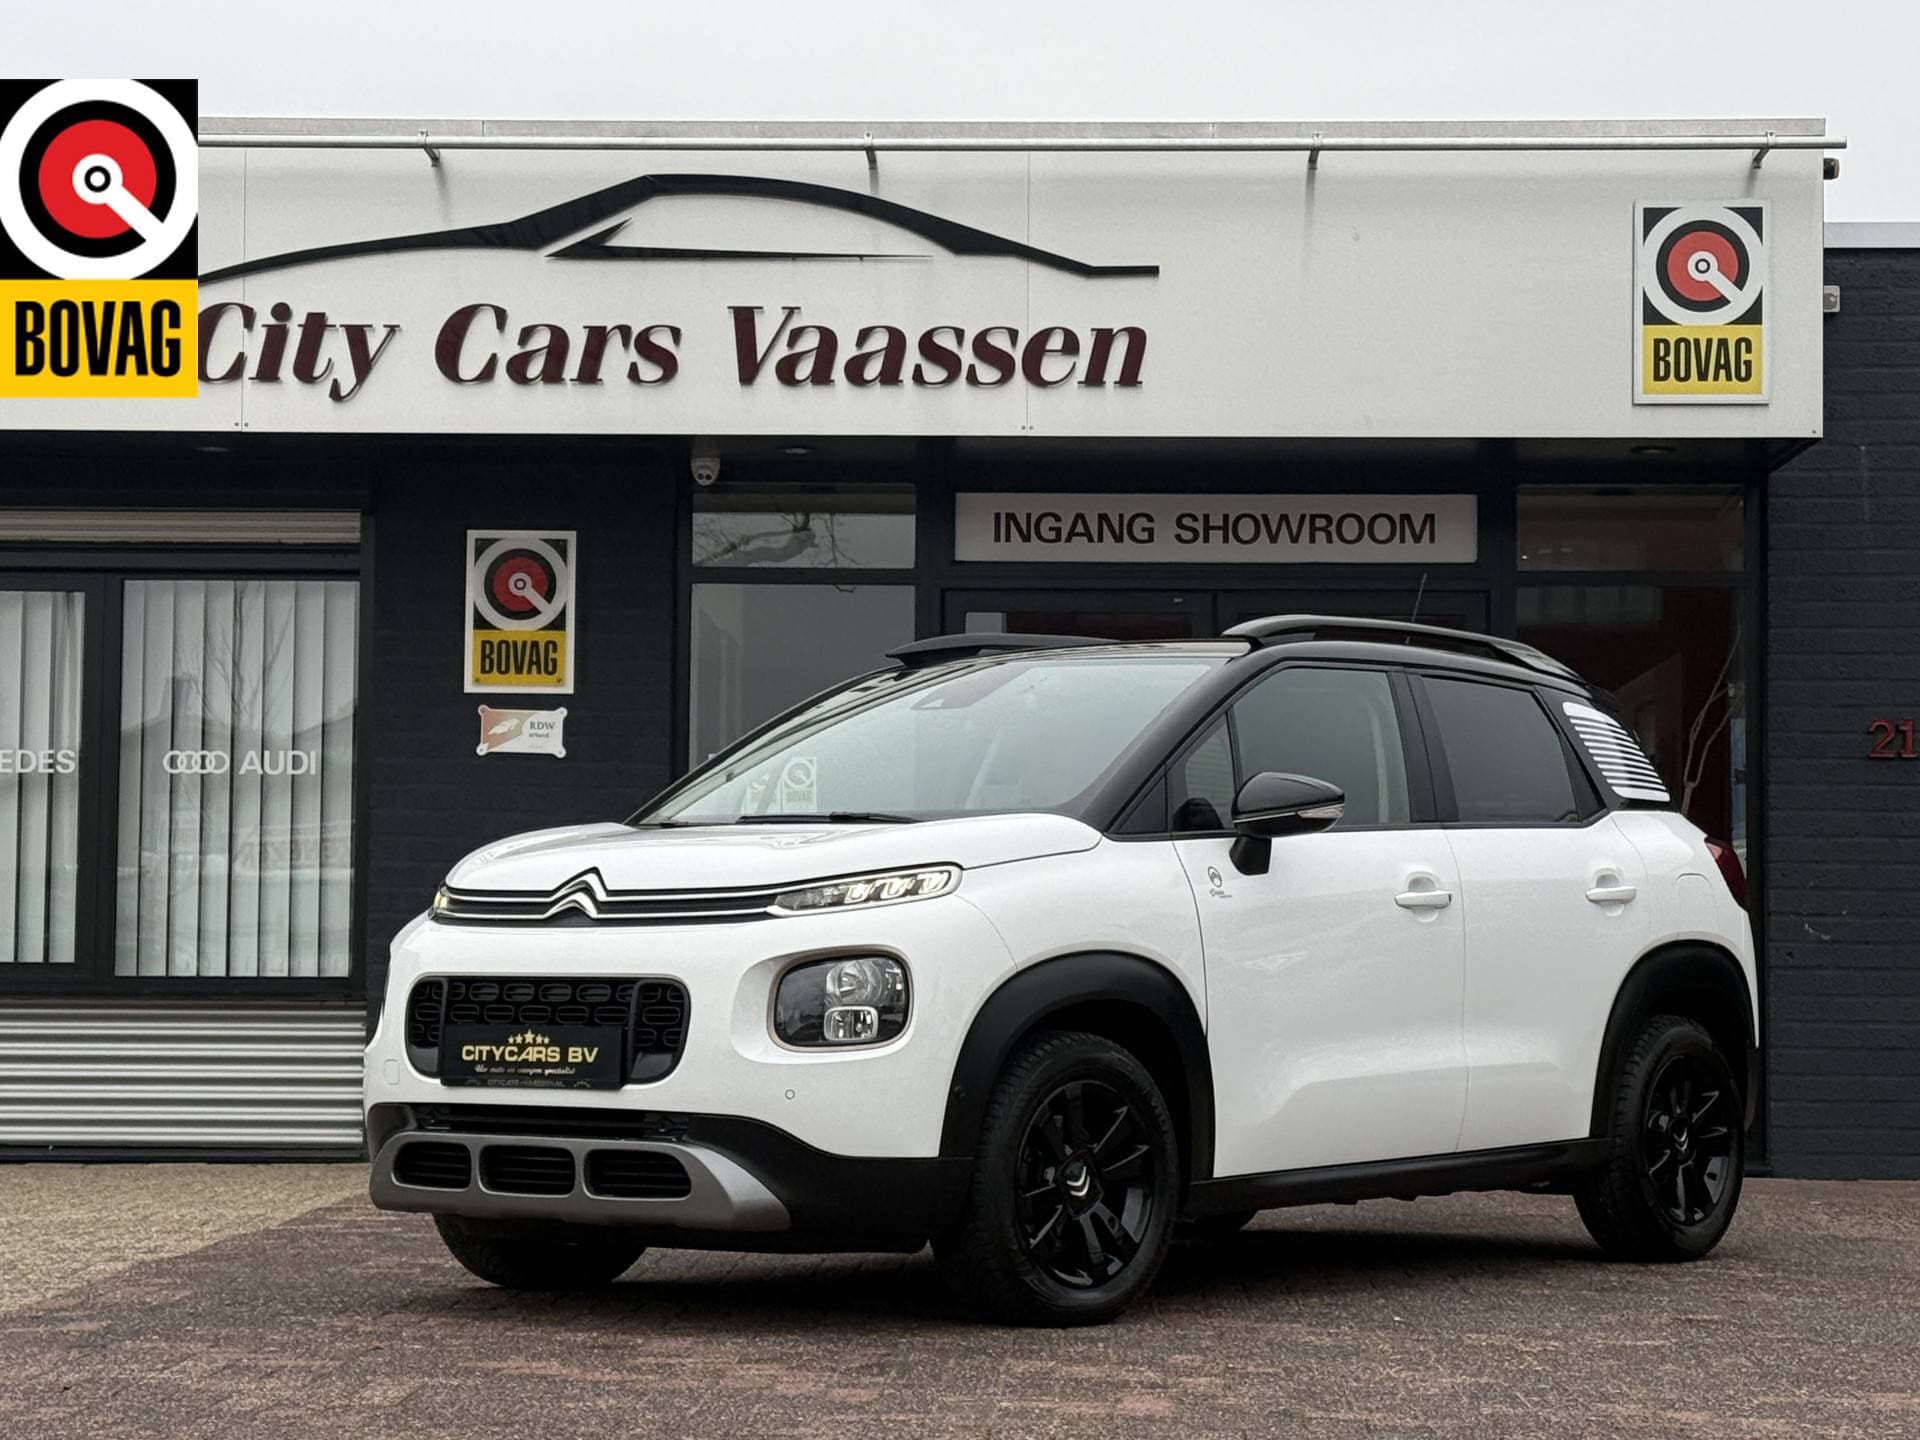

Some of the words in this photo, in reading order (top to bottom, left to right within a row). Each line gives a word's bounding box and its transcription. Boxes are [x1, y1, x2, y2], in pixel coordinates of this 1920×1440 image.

[198, 302, 401, 402] City
[434, 303, 684, 385] Cars
[728, 306, 1148, 388] Vaassen
[1653, 336, 1753, 383] BOVAG
[993, 511, 1155, 545] INGANG
[1174, 512, 1436, 545] SHOWROOM
[480, 639, 558, 676] BOVAG
[529, 721, 555, 730] RDW
[1867, 718, 1917, 758] 21
[0, 749, 76, 774] EDES
[239, 750, 316, 775] AUDI
[461, 1045, 561, 1062] CITYCARS
[567, 1047, 599, 1063] BV
